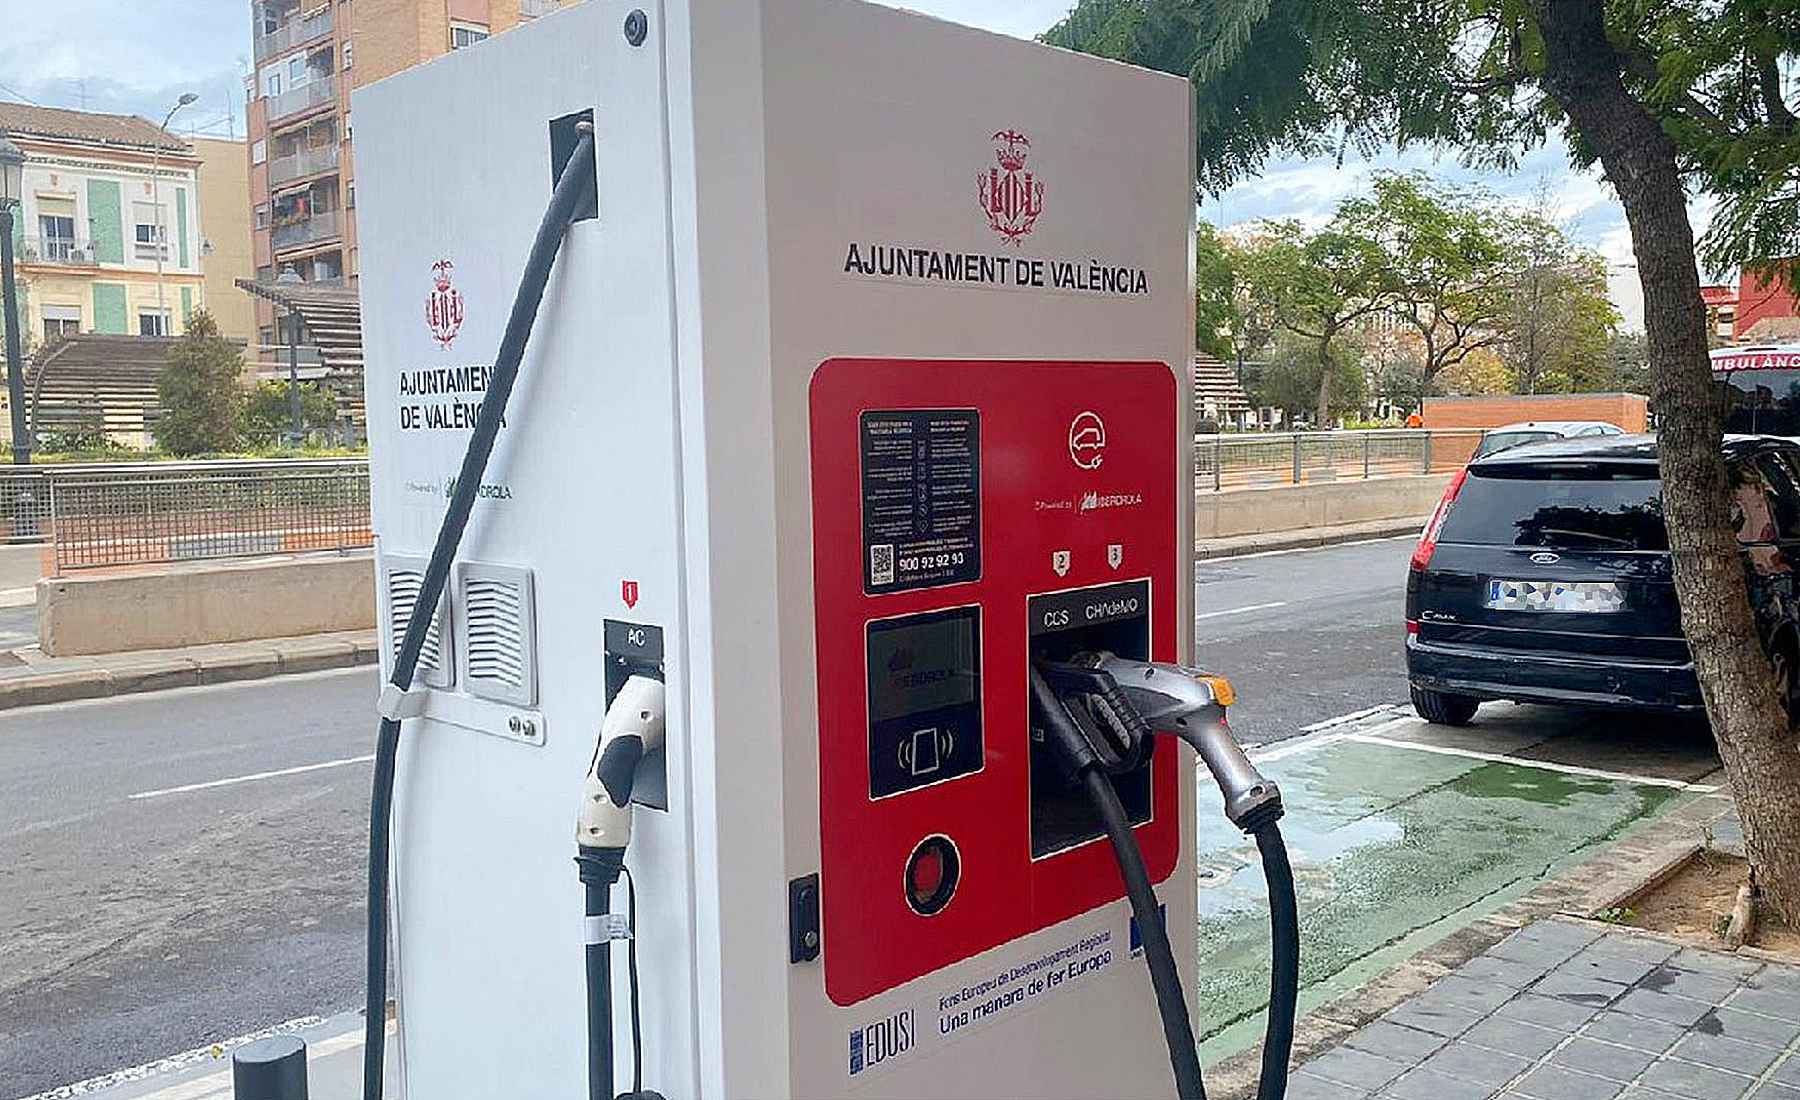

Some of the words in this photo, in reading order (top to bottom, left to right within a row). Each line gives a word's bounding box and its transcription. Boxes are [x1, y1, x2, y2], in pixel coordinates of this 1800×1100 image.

[845, 244, 1010, 285] AJUNTAMENT
[1016, 258, 1044, 287] DE
[1051, 260, 1148, 293] VALÈNCIA
[400, 366, 494, 395] AJUNTAMEN
[401, 405, 420, 429] DE
[424, 397, 506, 429] VALÈN
[899, 557, 918, 571] 900
[921, 556, 934, 569] 92
[936, 554, 949, 567] 92
[951, 552, 964, 565] 93
[1044, 609, 1069, 628] CCS
[627, 628, 645, 647] AC
[940, 1011, 969, 1034] Una
[1028, 977, 1044, 996] de
[1047, 969, 1066, 988] fer
[1068, 949, 1112, 979] Europa
